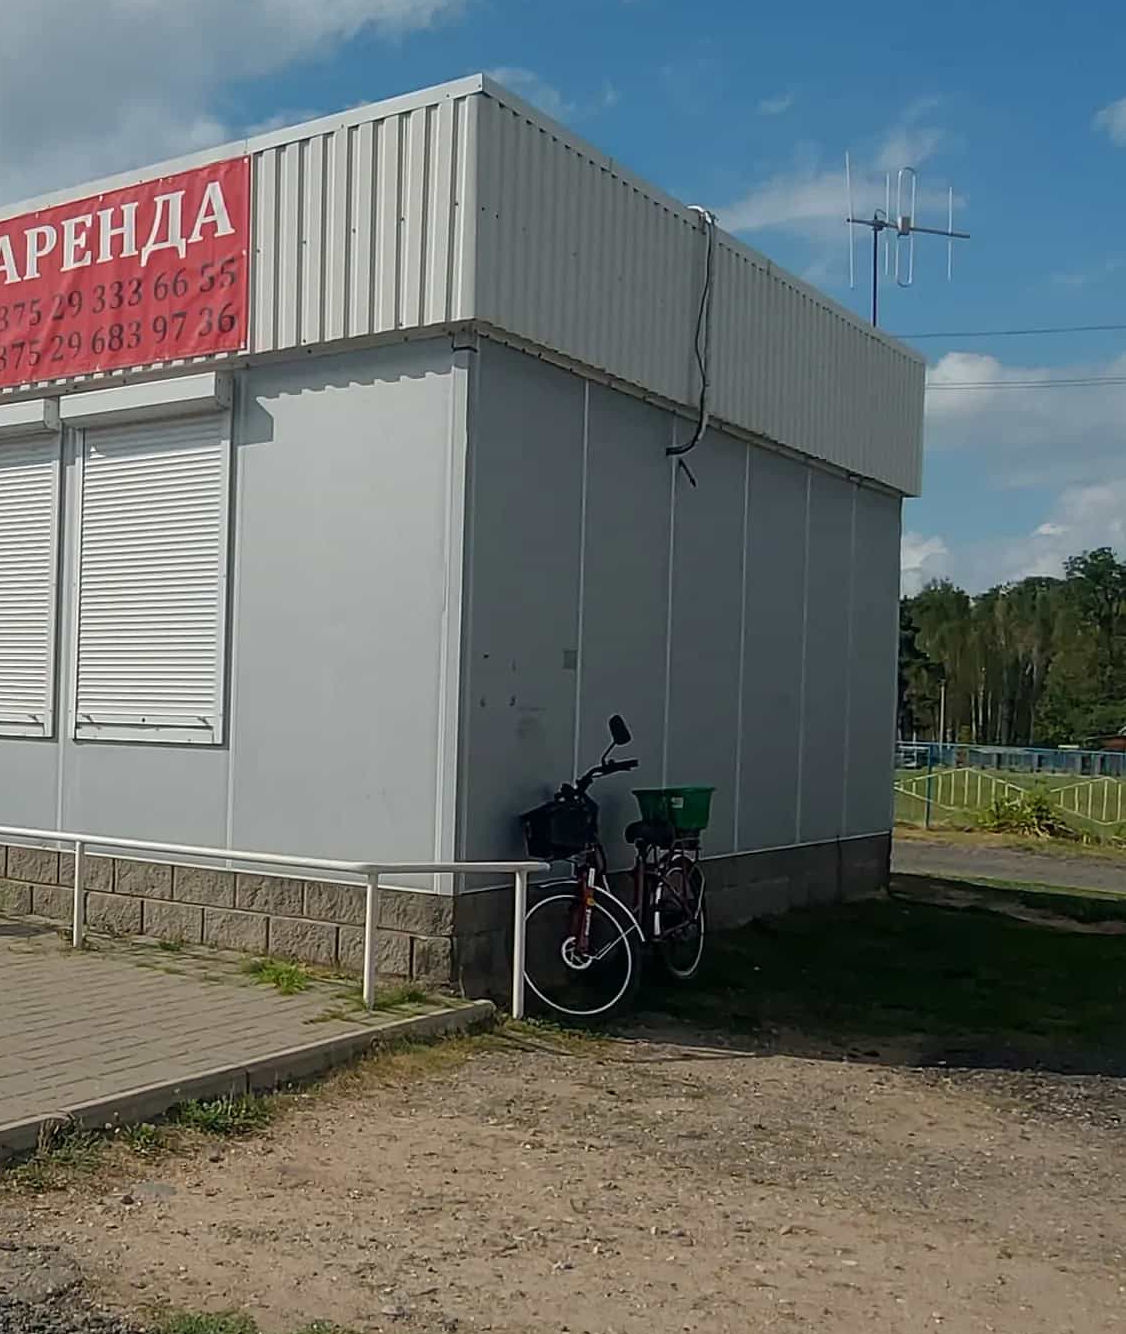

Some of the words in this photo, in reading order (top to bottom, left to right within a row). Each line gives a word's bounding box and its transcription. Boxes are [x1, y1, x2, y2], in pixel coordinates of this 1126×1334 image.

[51, 290, 83, 321] 29
[92, 277, 143, 314] 333
[153, 267, 189, 302] 66
[199, 257, 237, 293] 55
[50, 330, 82, 362] 29
[91, 320, 142, 355] 683
[152, 311, 188, 344] 97
[199, 302, 237, 337] 36
